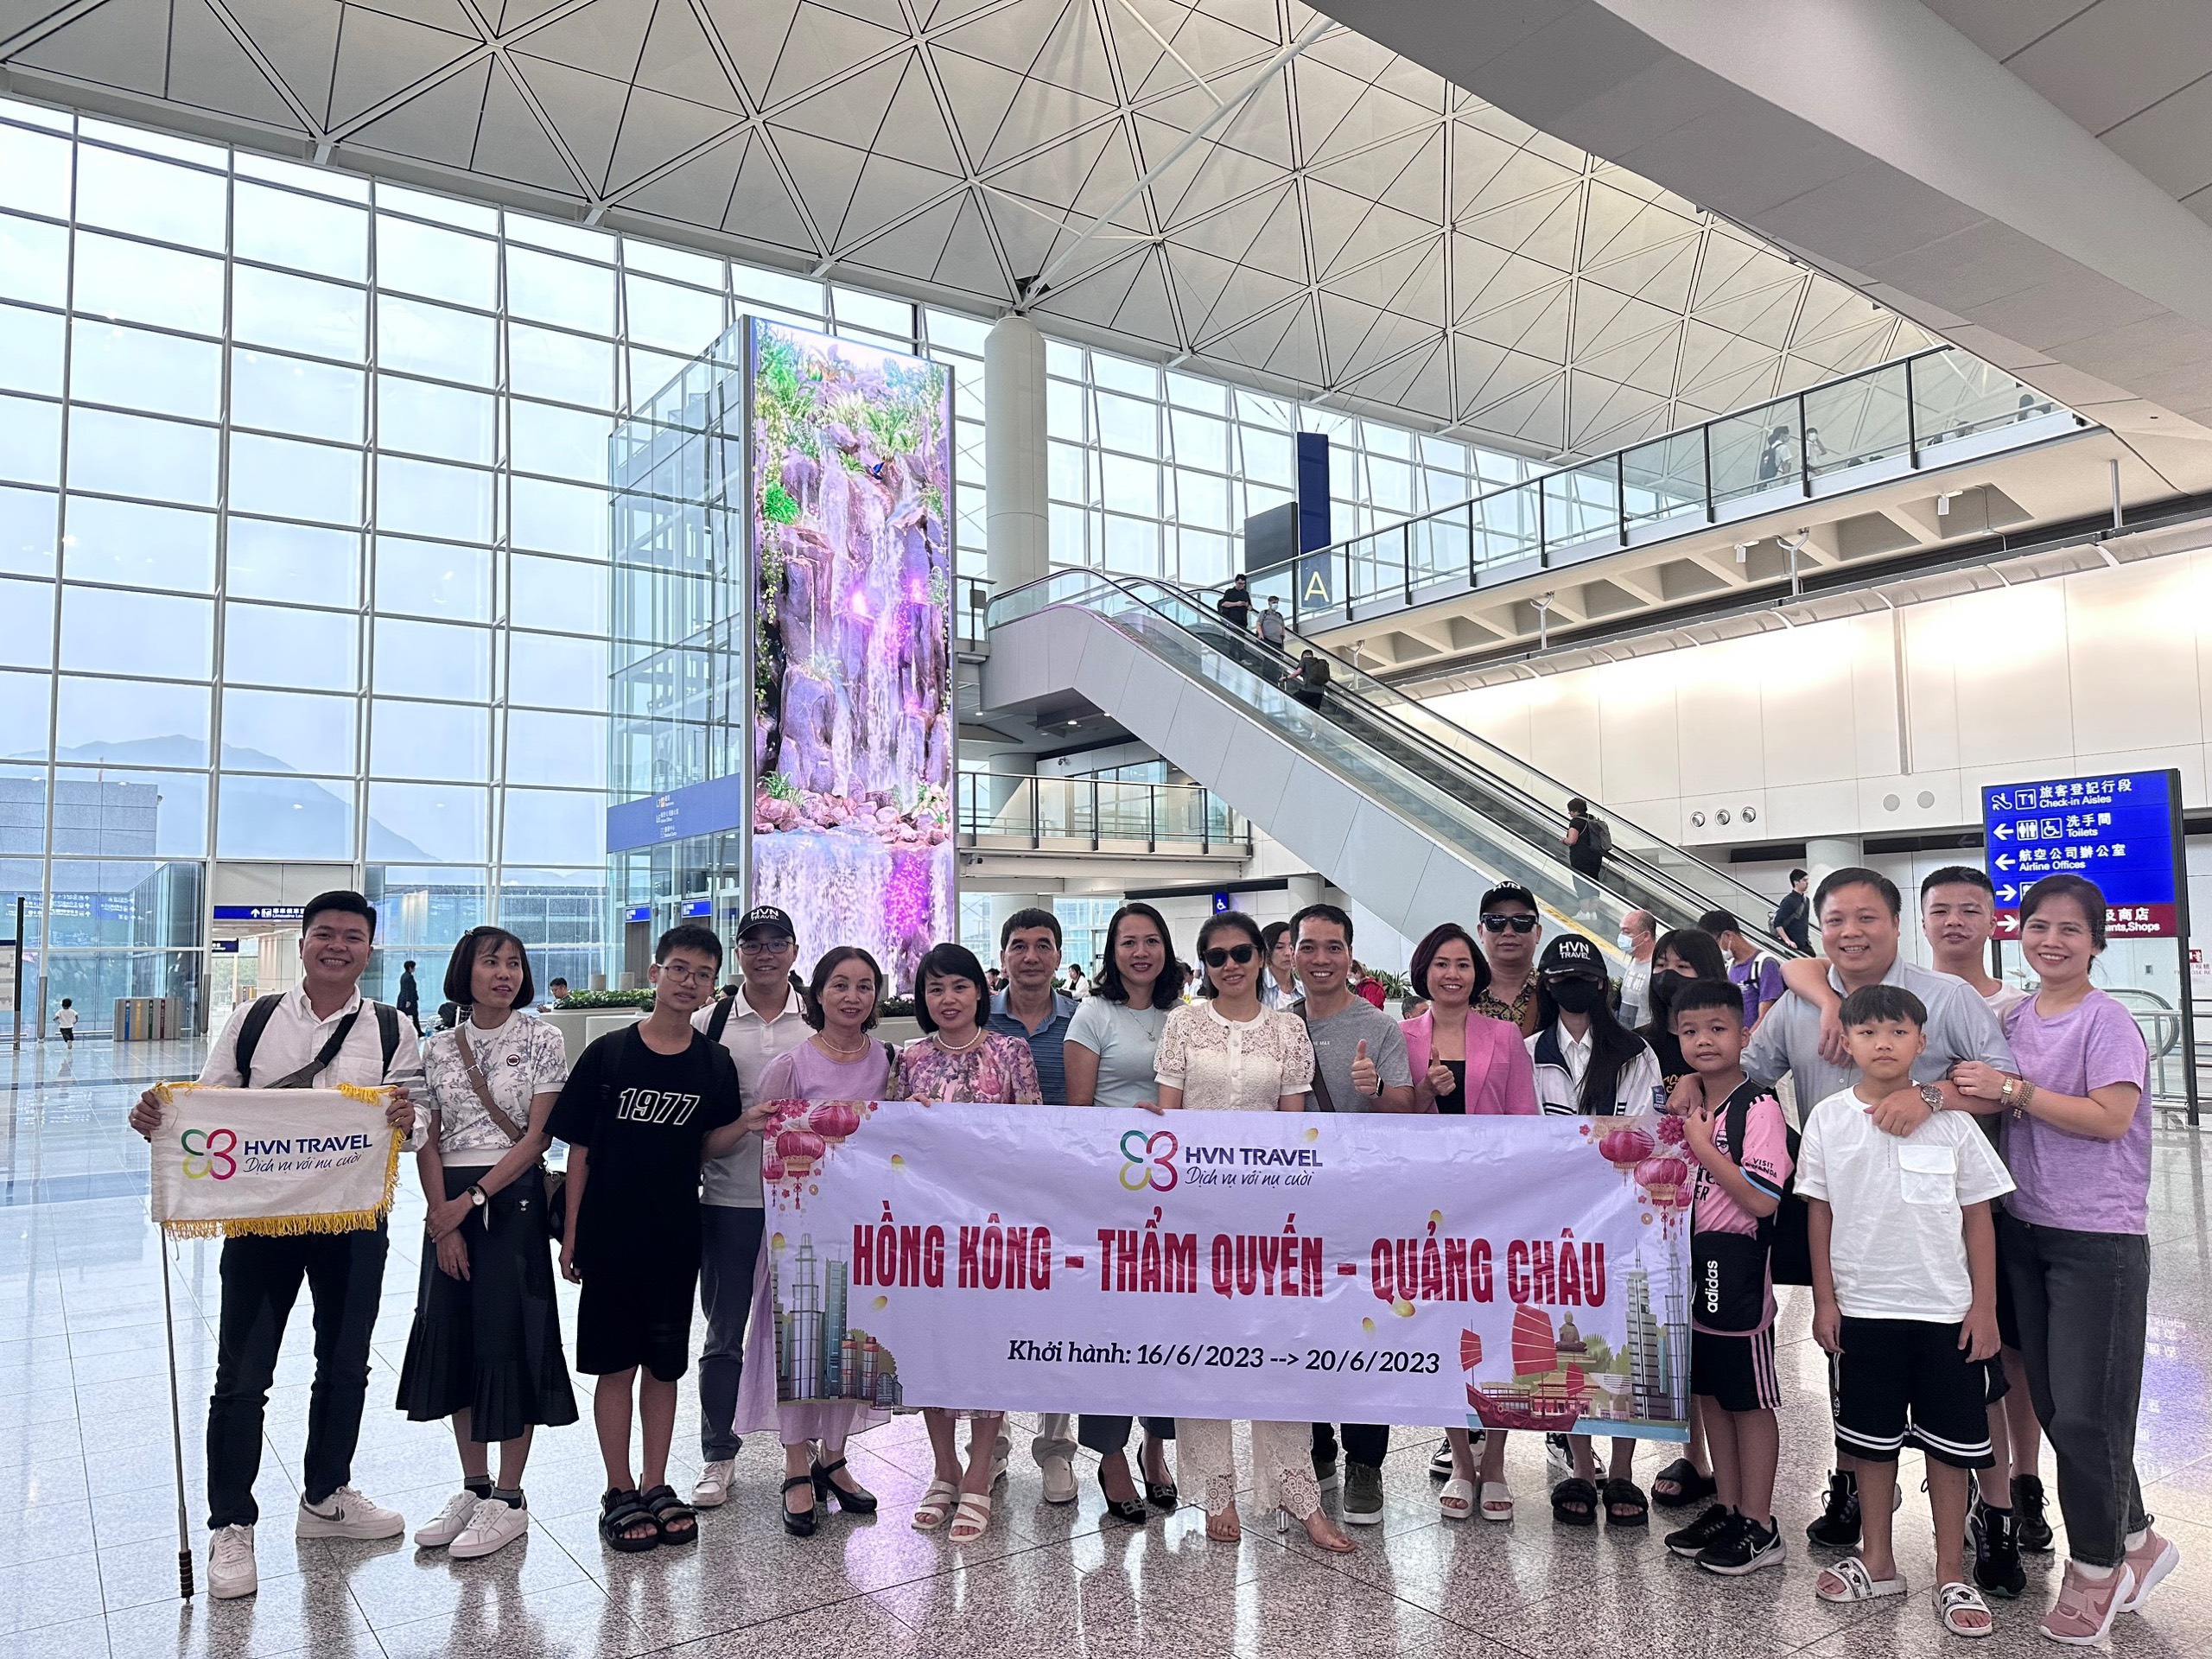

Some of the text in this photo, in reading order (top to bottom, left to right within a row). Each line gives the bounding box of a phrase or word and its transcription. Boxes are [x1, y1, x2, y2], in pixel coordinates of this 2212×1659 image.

[1304, 571, 1330, 602] A
[2039, 779, 2133, 799] 旅客登記行段
[2018, 793, 2034, 805] T1
[2039, 794, 2112, 809] Check-in Aisles
[2066, 812, 2112, 828] 洗手間
[2066, 827, 2098, 837] Toilets
[2018, 843, 2126, 862] 航空公司辦公室
[2018, 860, 2086, 871] Airline Offices
[751, 908, 779, 918] HVN
[2105, 906, 2150, 922] 及商店
[2104, 921, 2161, 933] ants,Shops
[1559, 941, 1589, 954] HVN
[1560, 951, 1591, 960] TRAVEL
[617, 1088, 701, 1126] 1977
[244, 1134, 372, 1156] HVN TRAVEL
[243, 1152, 364, 1175] Dịch vụ với nụ cười
[1185, 1147, 1323, 1167] HVN TRAVEL
[1753, 1158, 1774, 1169] VISIT
[1185, 1166, 1315, 1189] Dịch vụ với nụ cười
[853, 1200, 945, 1288] HỒNG
[958, 1212, 1052, 1291] KÔNG
[1097, 1205, 1198, 1294] THẨM
[1211, 1213, 1324, 1300] QUYẾN
[1370, 1220, 1494, 1306] QUẢNG
[1507, 1227, 1606, 1307] CHÂU
[1705, 1260, 1719, 1313] adidas
[1007, 1339, 1064, 1363] Khởi
[1068, 1341, 1131, 1363] hành:
[1137, 1344, 1264, 1368] 16/6/2023
[1306, 1349, 1441, 1374] 20/6/2023
